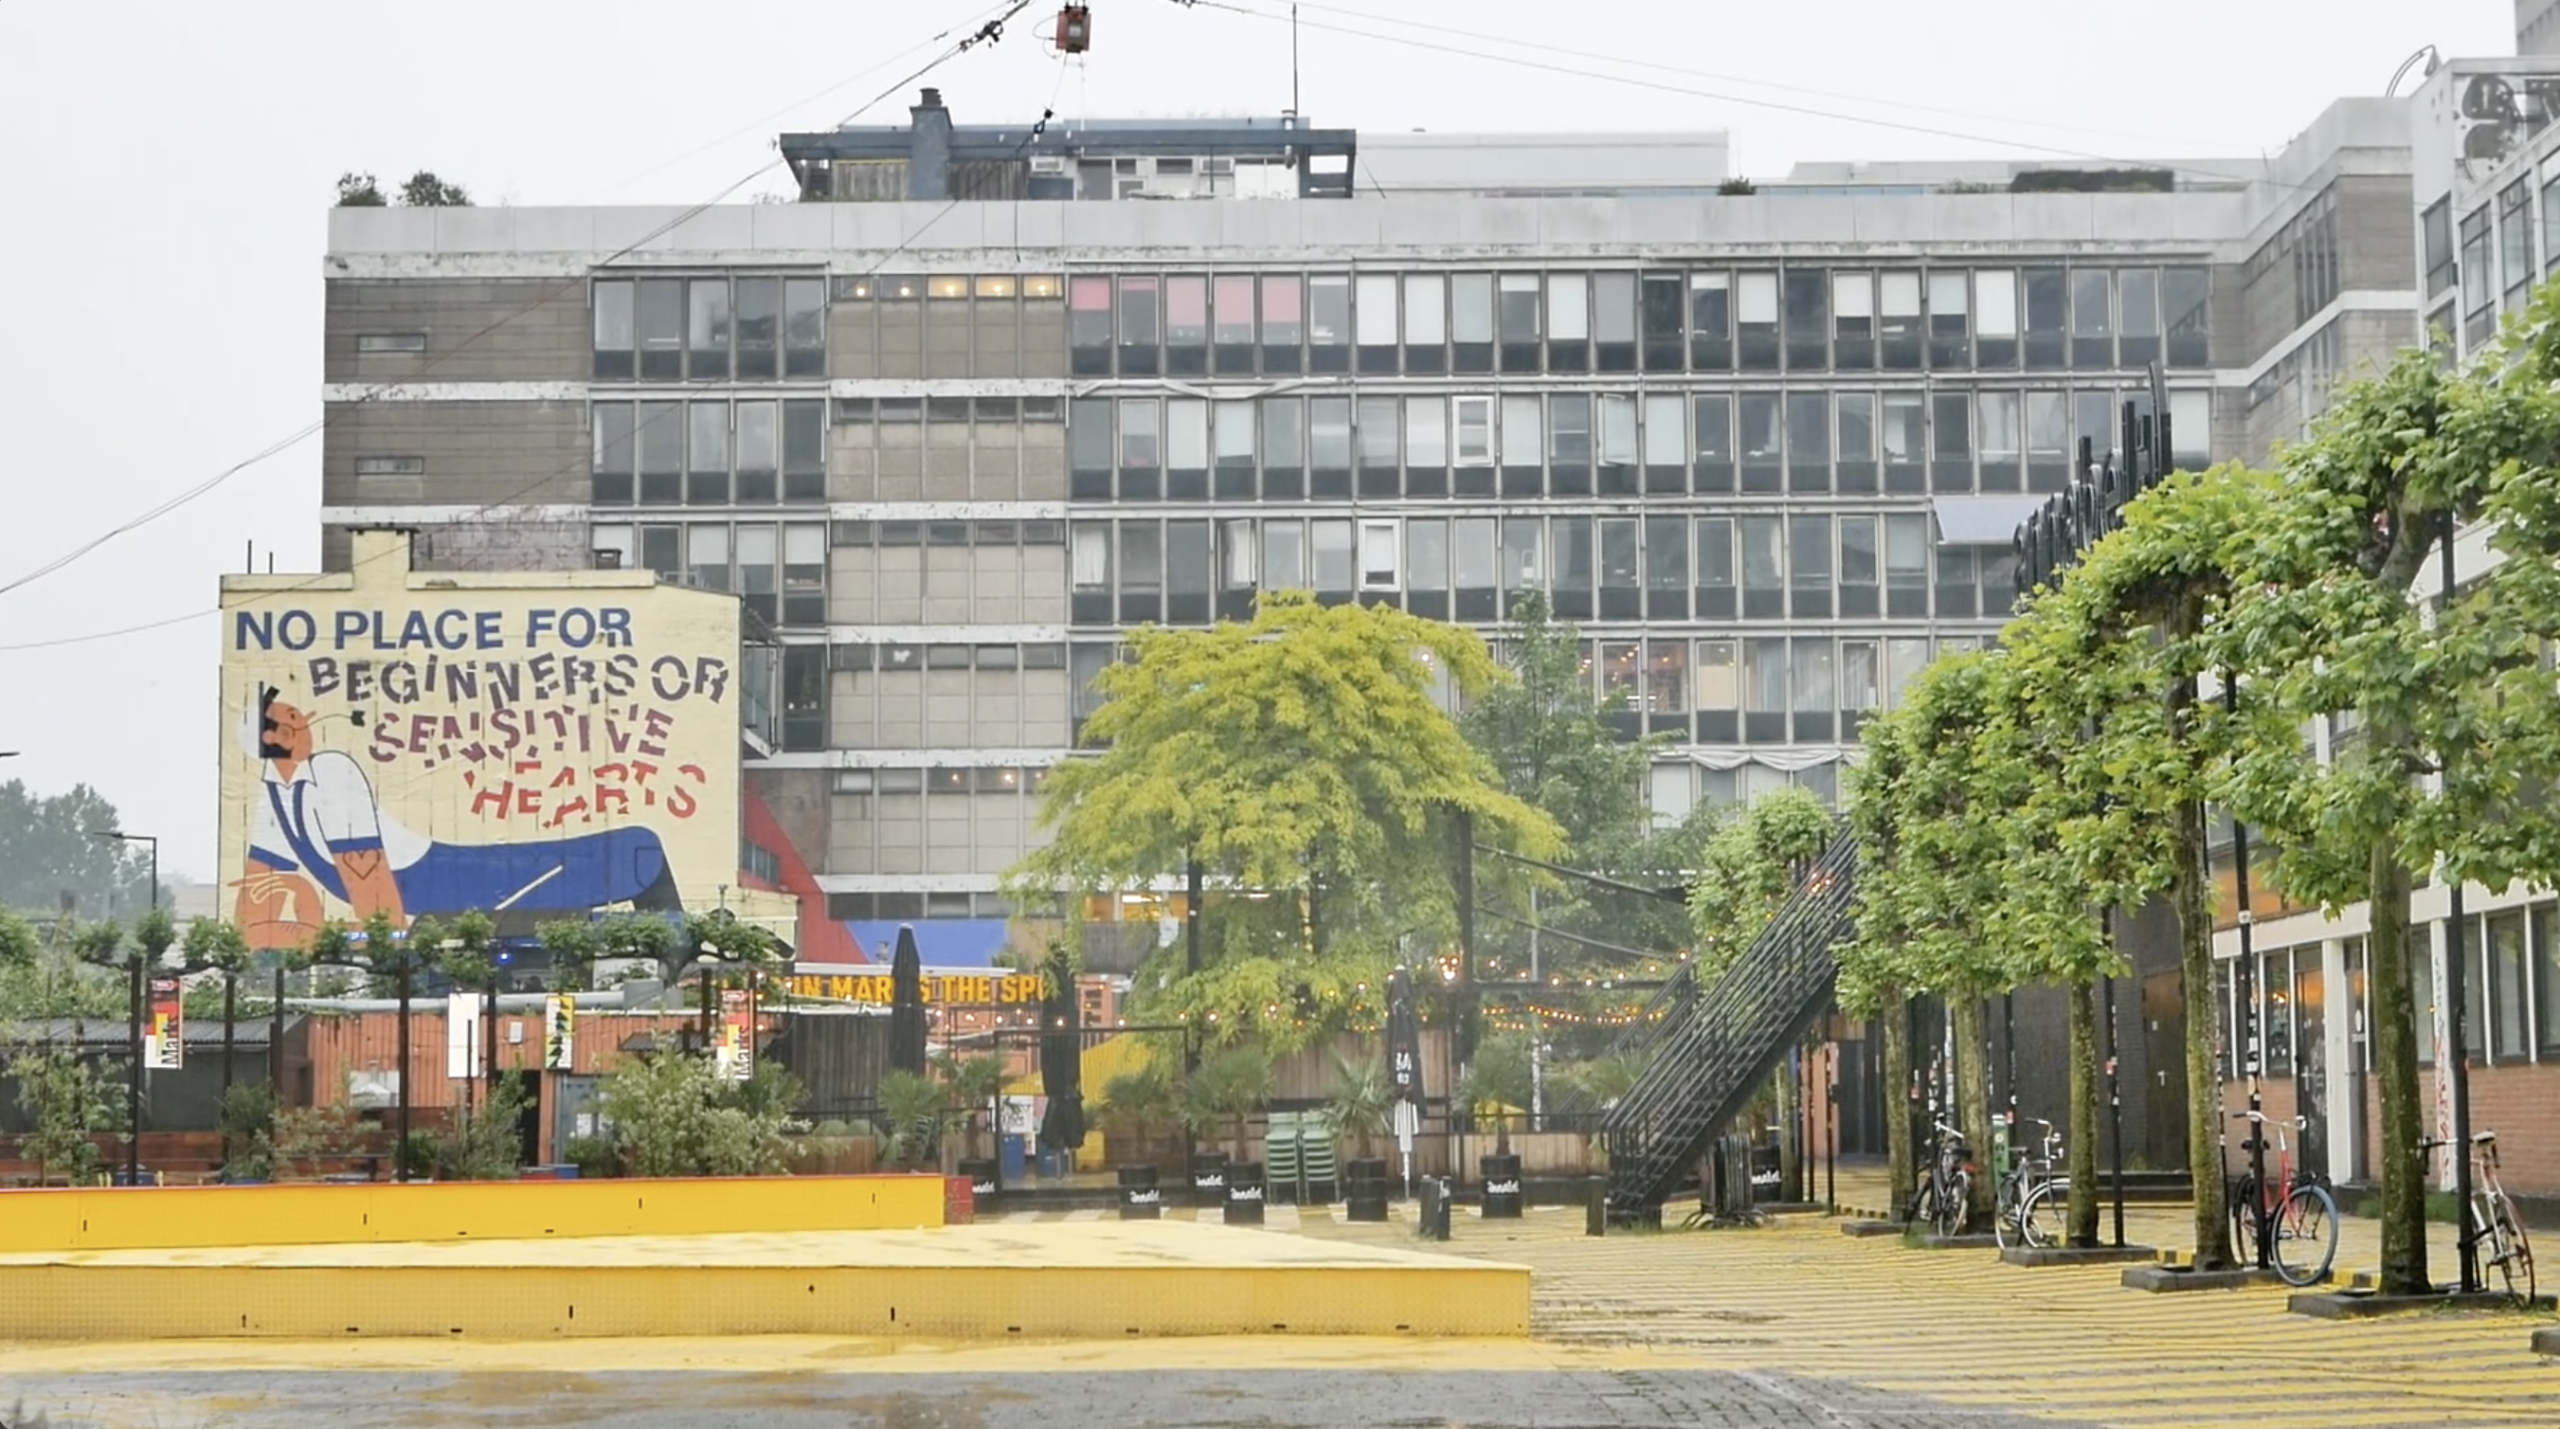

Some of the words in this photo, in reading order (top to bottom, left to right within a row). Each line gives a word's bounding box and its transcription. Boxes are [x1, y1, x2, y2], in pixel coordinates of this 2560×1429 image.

[236, 609, 317, 651] NO
[335, 609, 504, 651] PLACE
[526, 607, 633, 649] FOR
[308, 652, 639, 710] BEGINNERS
[651, 655, 730, 704] OR
[369, 704, 675, 768] SENSITIVE
[463, 760, 706, 828] HEARTS
[831, 975, 932, 1003] MARS
[942, 975, 992, 1003] THE
